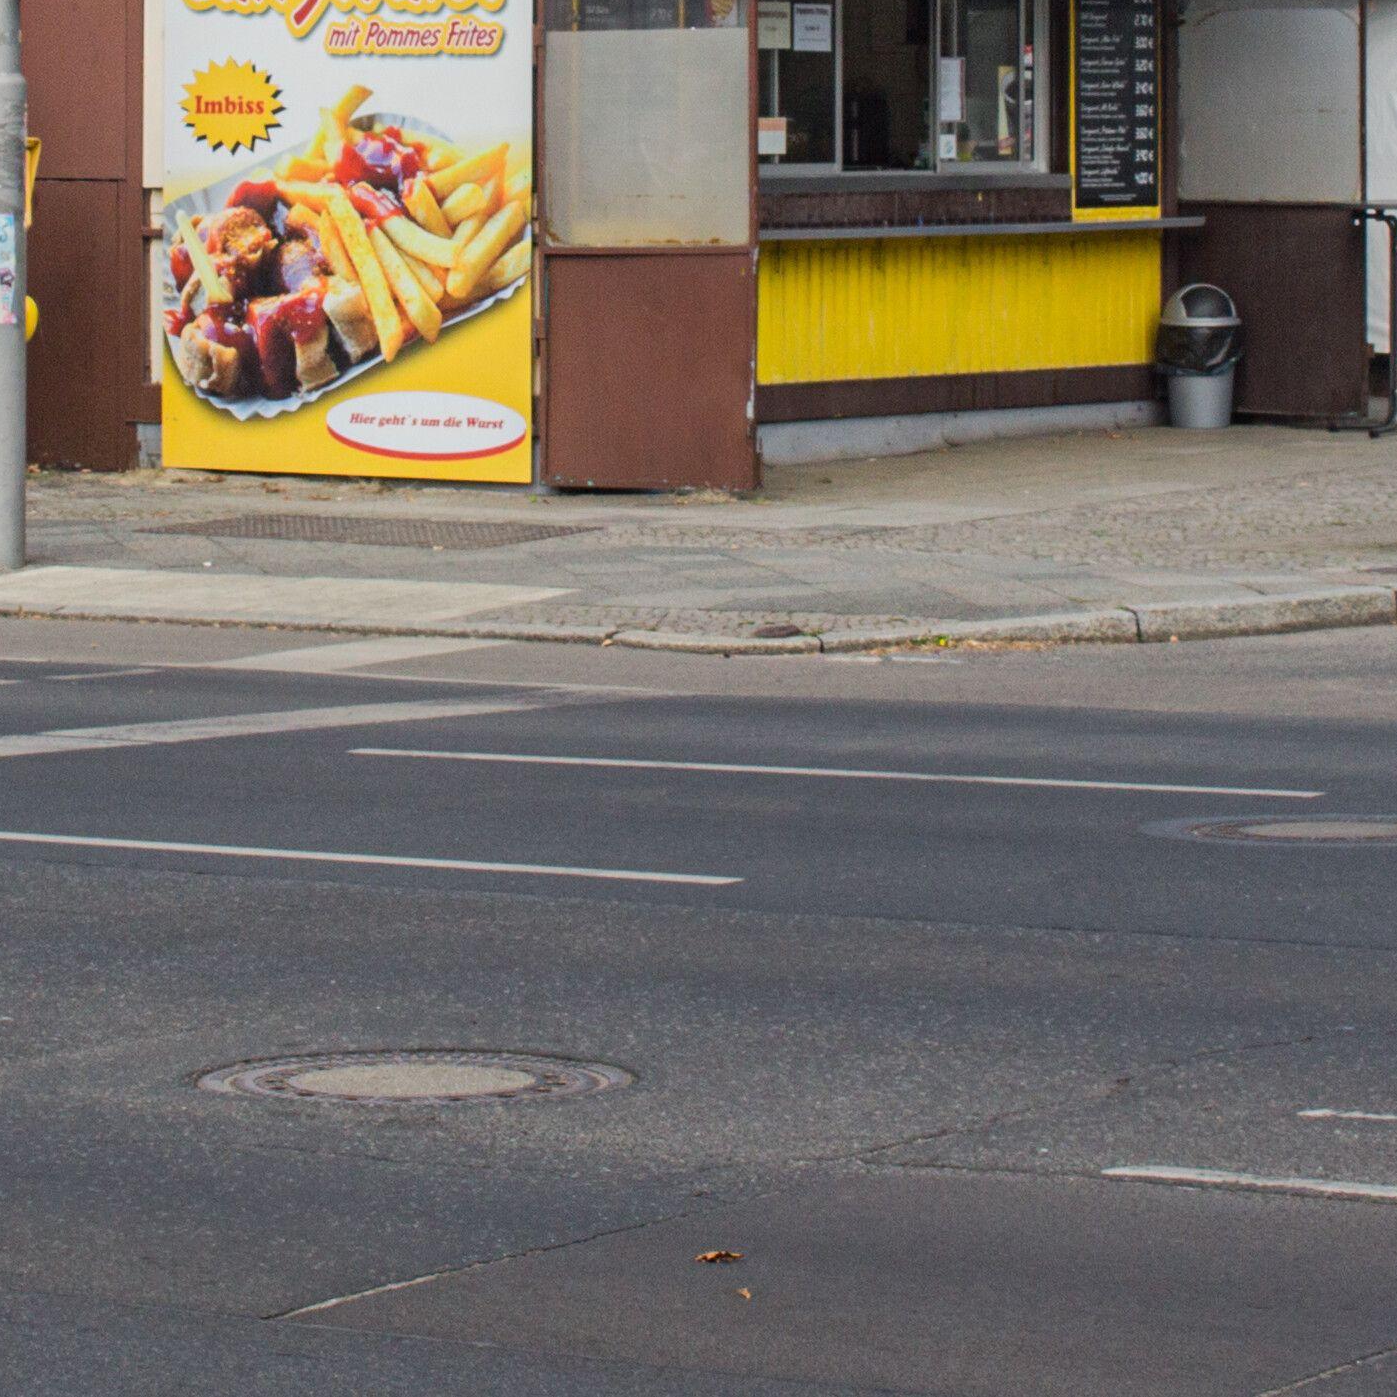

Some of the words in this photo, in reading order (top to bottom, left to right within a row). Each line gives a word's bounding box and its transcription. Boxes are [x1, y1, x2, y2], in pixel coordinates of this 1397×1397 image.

[328, 23, 361, 47] mit
[365, 21, 440, 47] Pommes
[446, 21, 498, 47] Frites
[194, 95, 265, 115] Imbiss
[350, 412, 375, 425] Hier
[421, 417, 440, 427] um
[443, 416, 462, 427] die
[466, 416, 504, 429] Wurst
